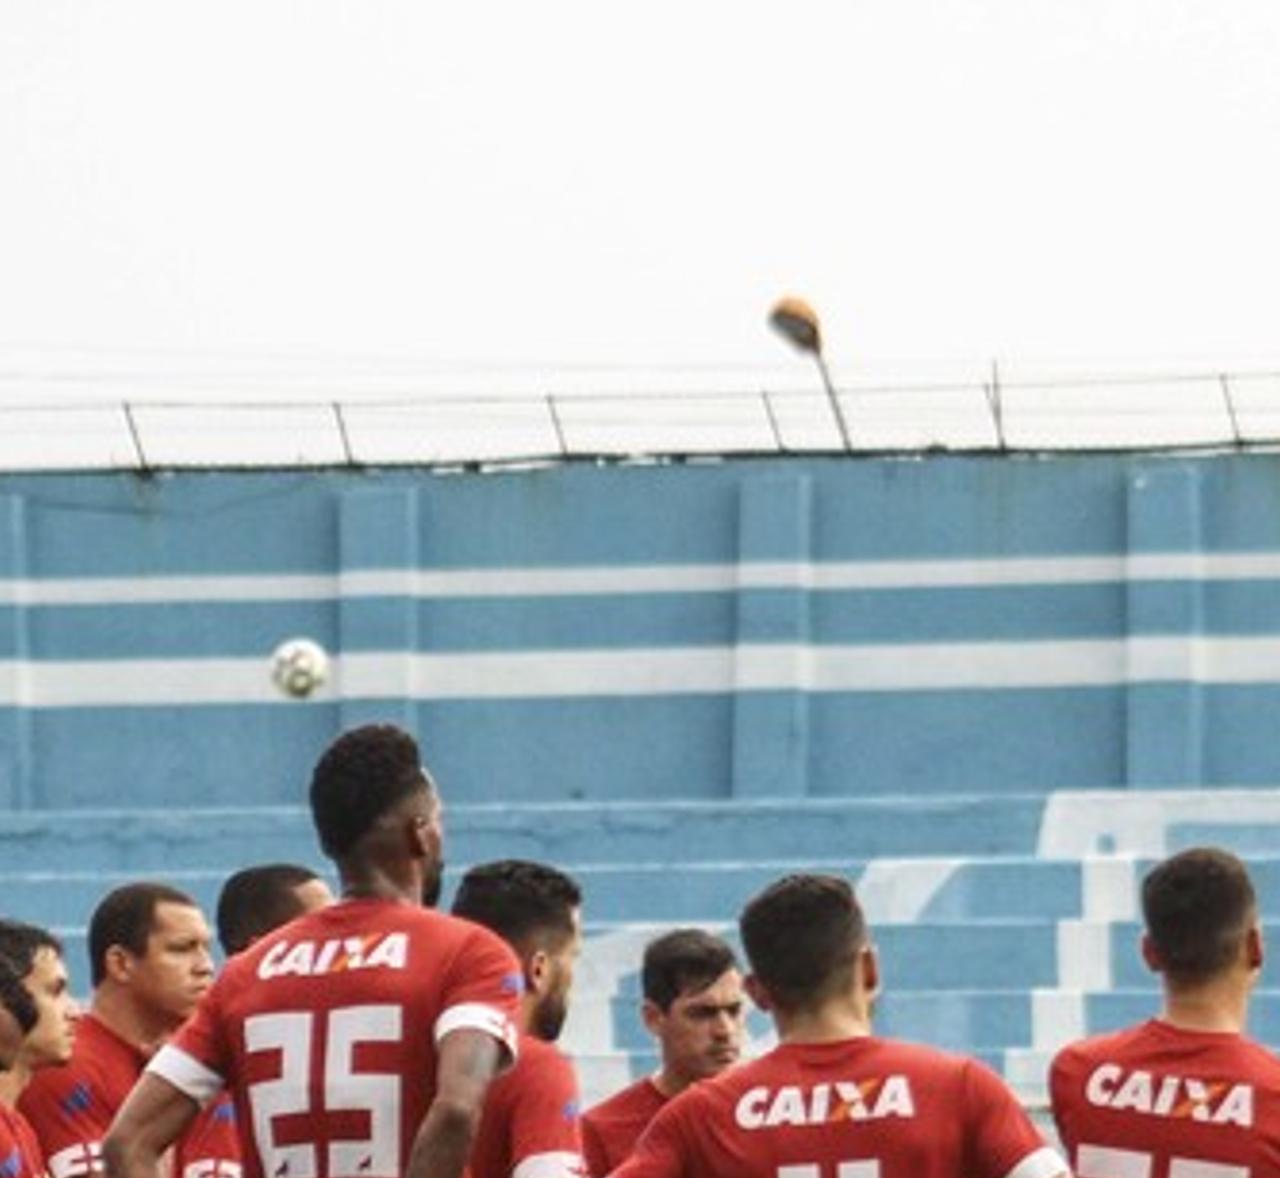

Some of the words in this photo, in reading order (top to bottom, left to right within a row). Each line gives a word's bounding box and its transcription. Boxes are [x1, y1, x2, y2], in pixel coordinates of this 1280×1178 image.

[257, 932, 409, 980] CAIXA
[734, 1074, 915, 1130] CAIXA
[1086, 1063, 1253, 1127] CAIXA
